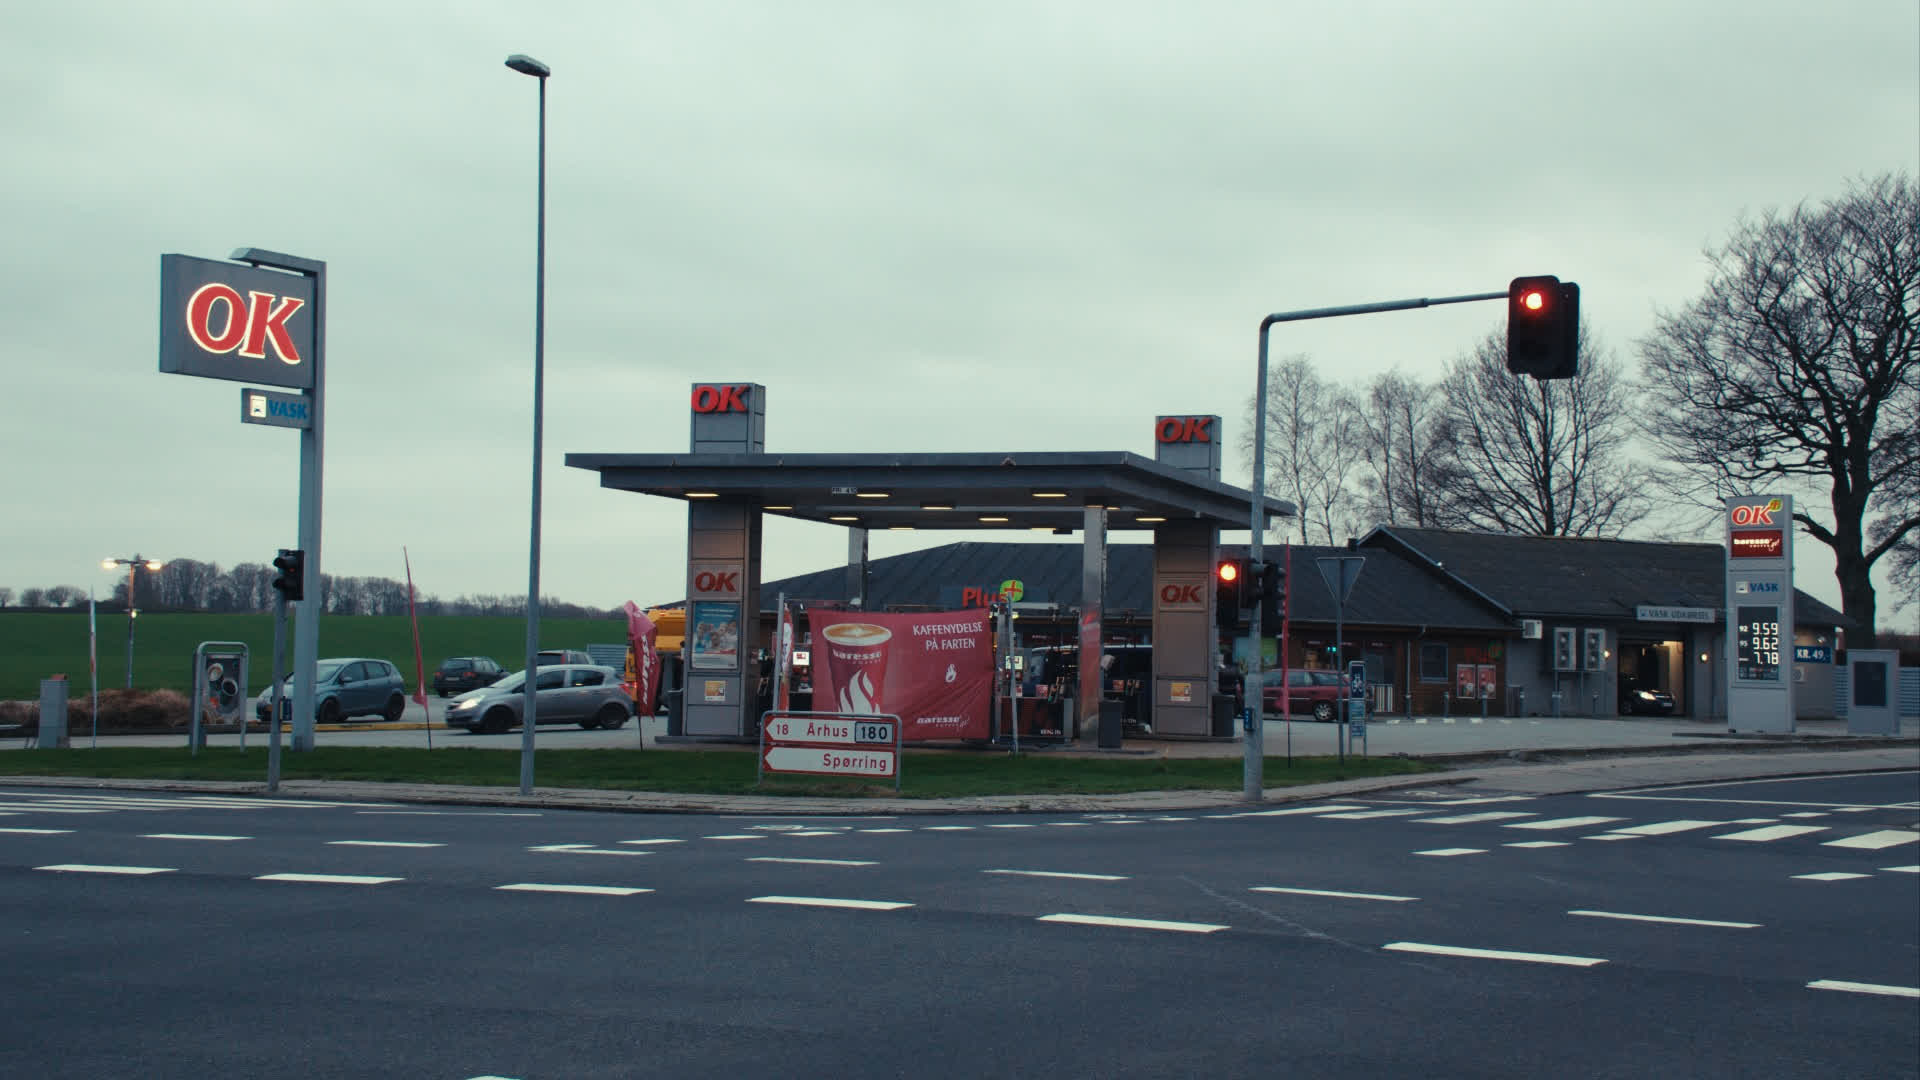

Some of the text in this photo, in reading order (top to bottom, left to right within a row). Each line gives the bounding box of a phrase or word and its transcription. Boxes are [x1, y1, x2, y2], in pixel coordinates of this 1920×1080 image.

[186, 283, 305, 365] OK
[691, 385, 750, 413] OK
[268, 399, 308, 419] VASK
[1155, 418, 1212, 443] OK
[1731, 505, 1774, 525] OK
[695, 571, 739, 593] OK
[1750, 582, 1779, 592] VASK
[1161, 584, 1204, 603] OK
[912, 621, 983, 636] KAFFENYDELSE
[1752, 622, 1779, 635] 9.59
[925, 638, 976, 651] PÅ FARTEN
[1752, 637, 1779, 650] 9.62
[1753, 651, 1779, 665] 7.78
[776, 721, 888, 740] 18 Århus 180
[822, 752, 887, 772] Spørring
